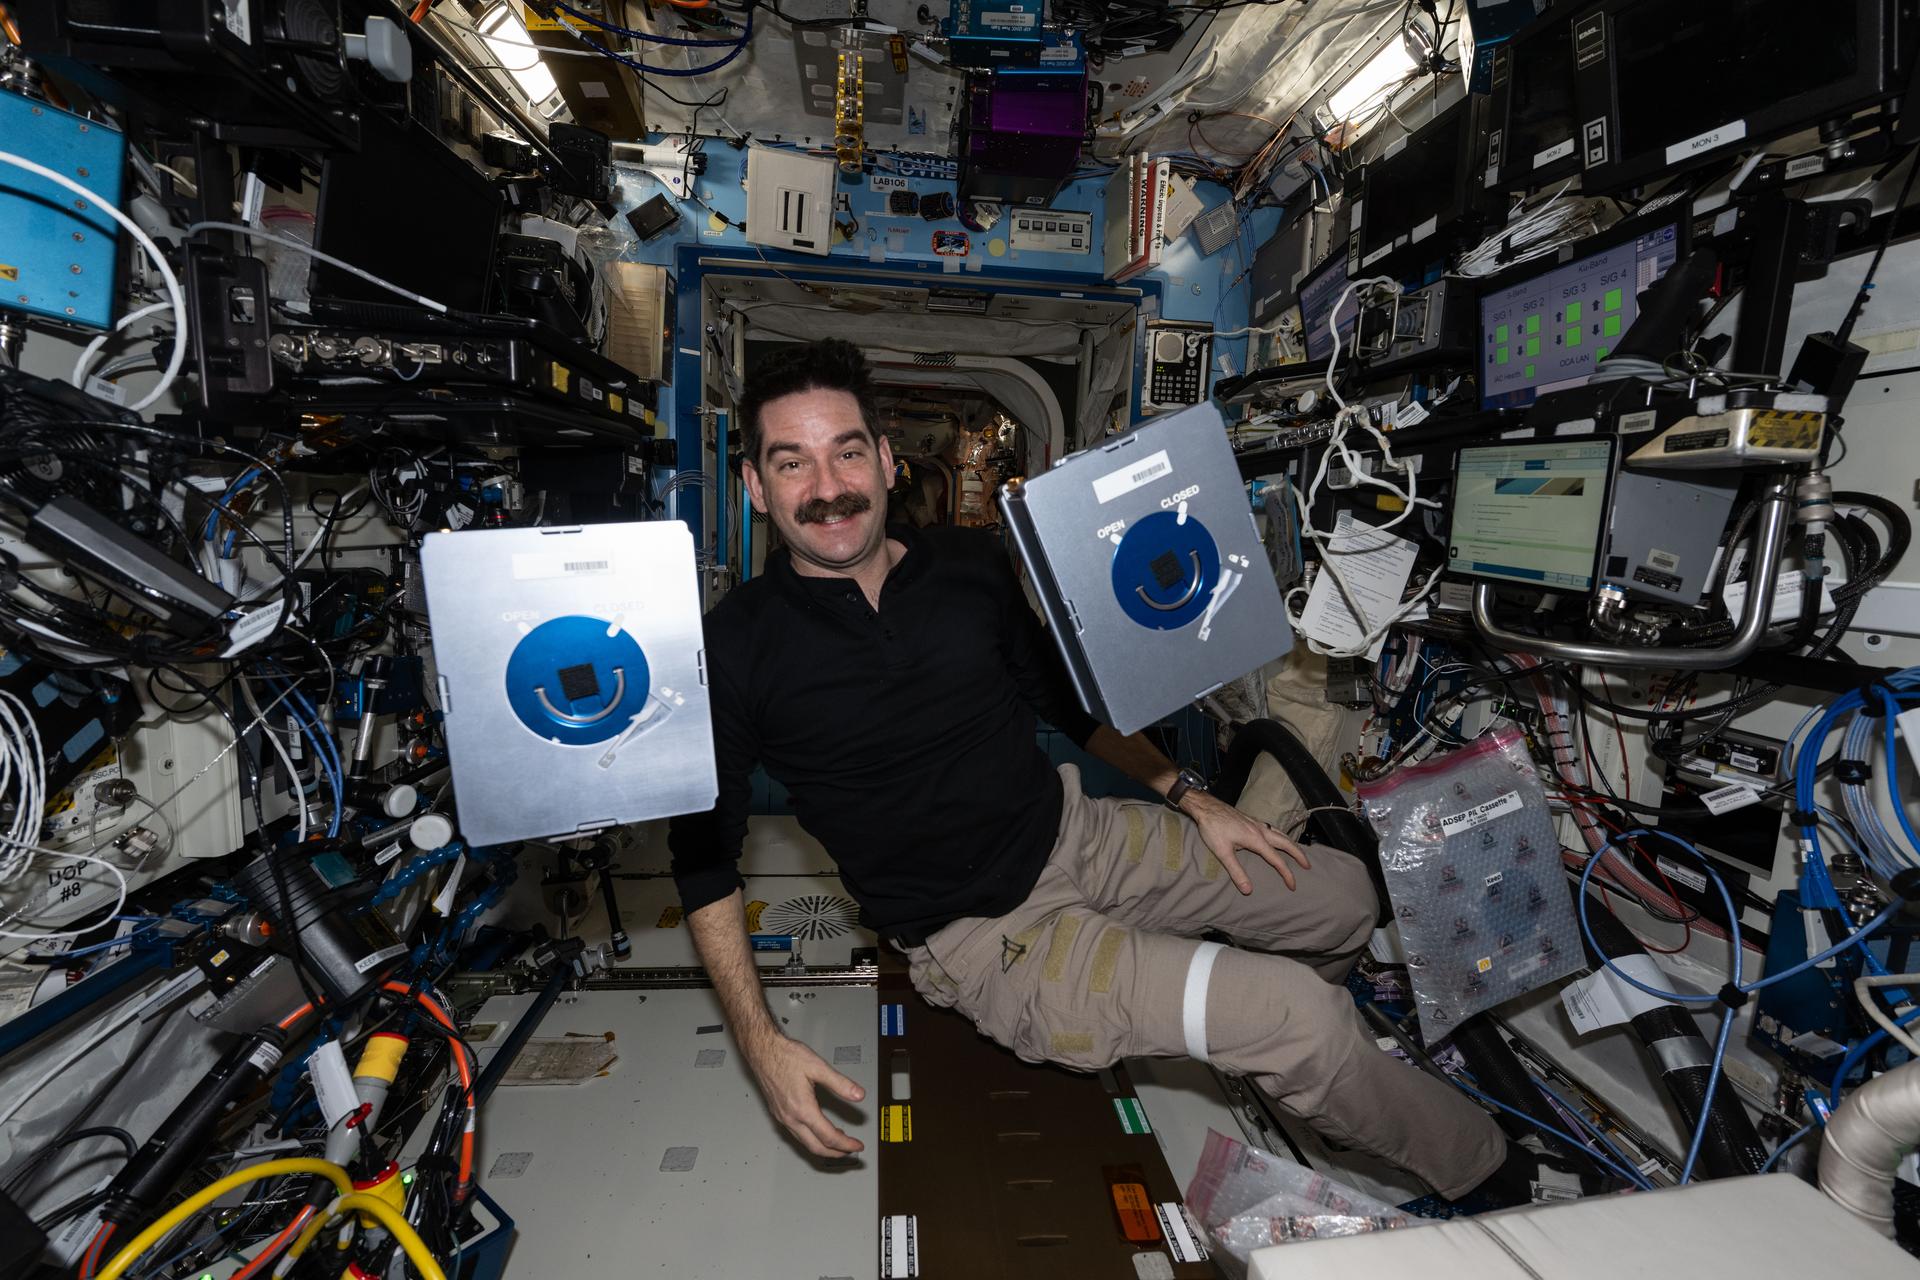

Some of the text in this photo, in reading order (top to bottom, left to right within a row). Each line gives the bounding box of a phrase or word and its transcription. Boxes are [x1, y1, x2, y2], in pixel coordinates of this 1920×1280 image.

[1692, 134, 1719, 149] MON 3
[1546, 149, 1557, 159] MON
[1139, 179, 1148, 237] WARNING
[1600, 269, 1627, 286] S/G 4
[1563, 283, 1587, 299] S/G 3
[1523, 297, 1545, 312] S/G 2
[1493, 310, 1506, 322] S/G
[1576, 353, 1590, 364] LAN
[1160, 484, 1199, 509] CLOSED
[1097, 519, 1126, 539] OPEN
[502, 610, 541, 623] OPEN
[1442, 813, 1466, 827] ADSEP
[1479, 798, 1508, 814] Cassette
[60, 882, 81, 902] #8
